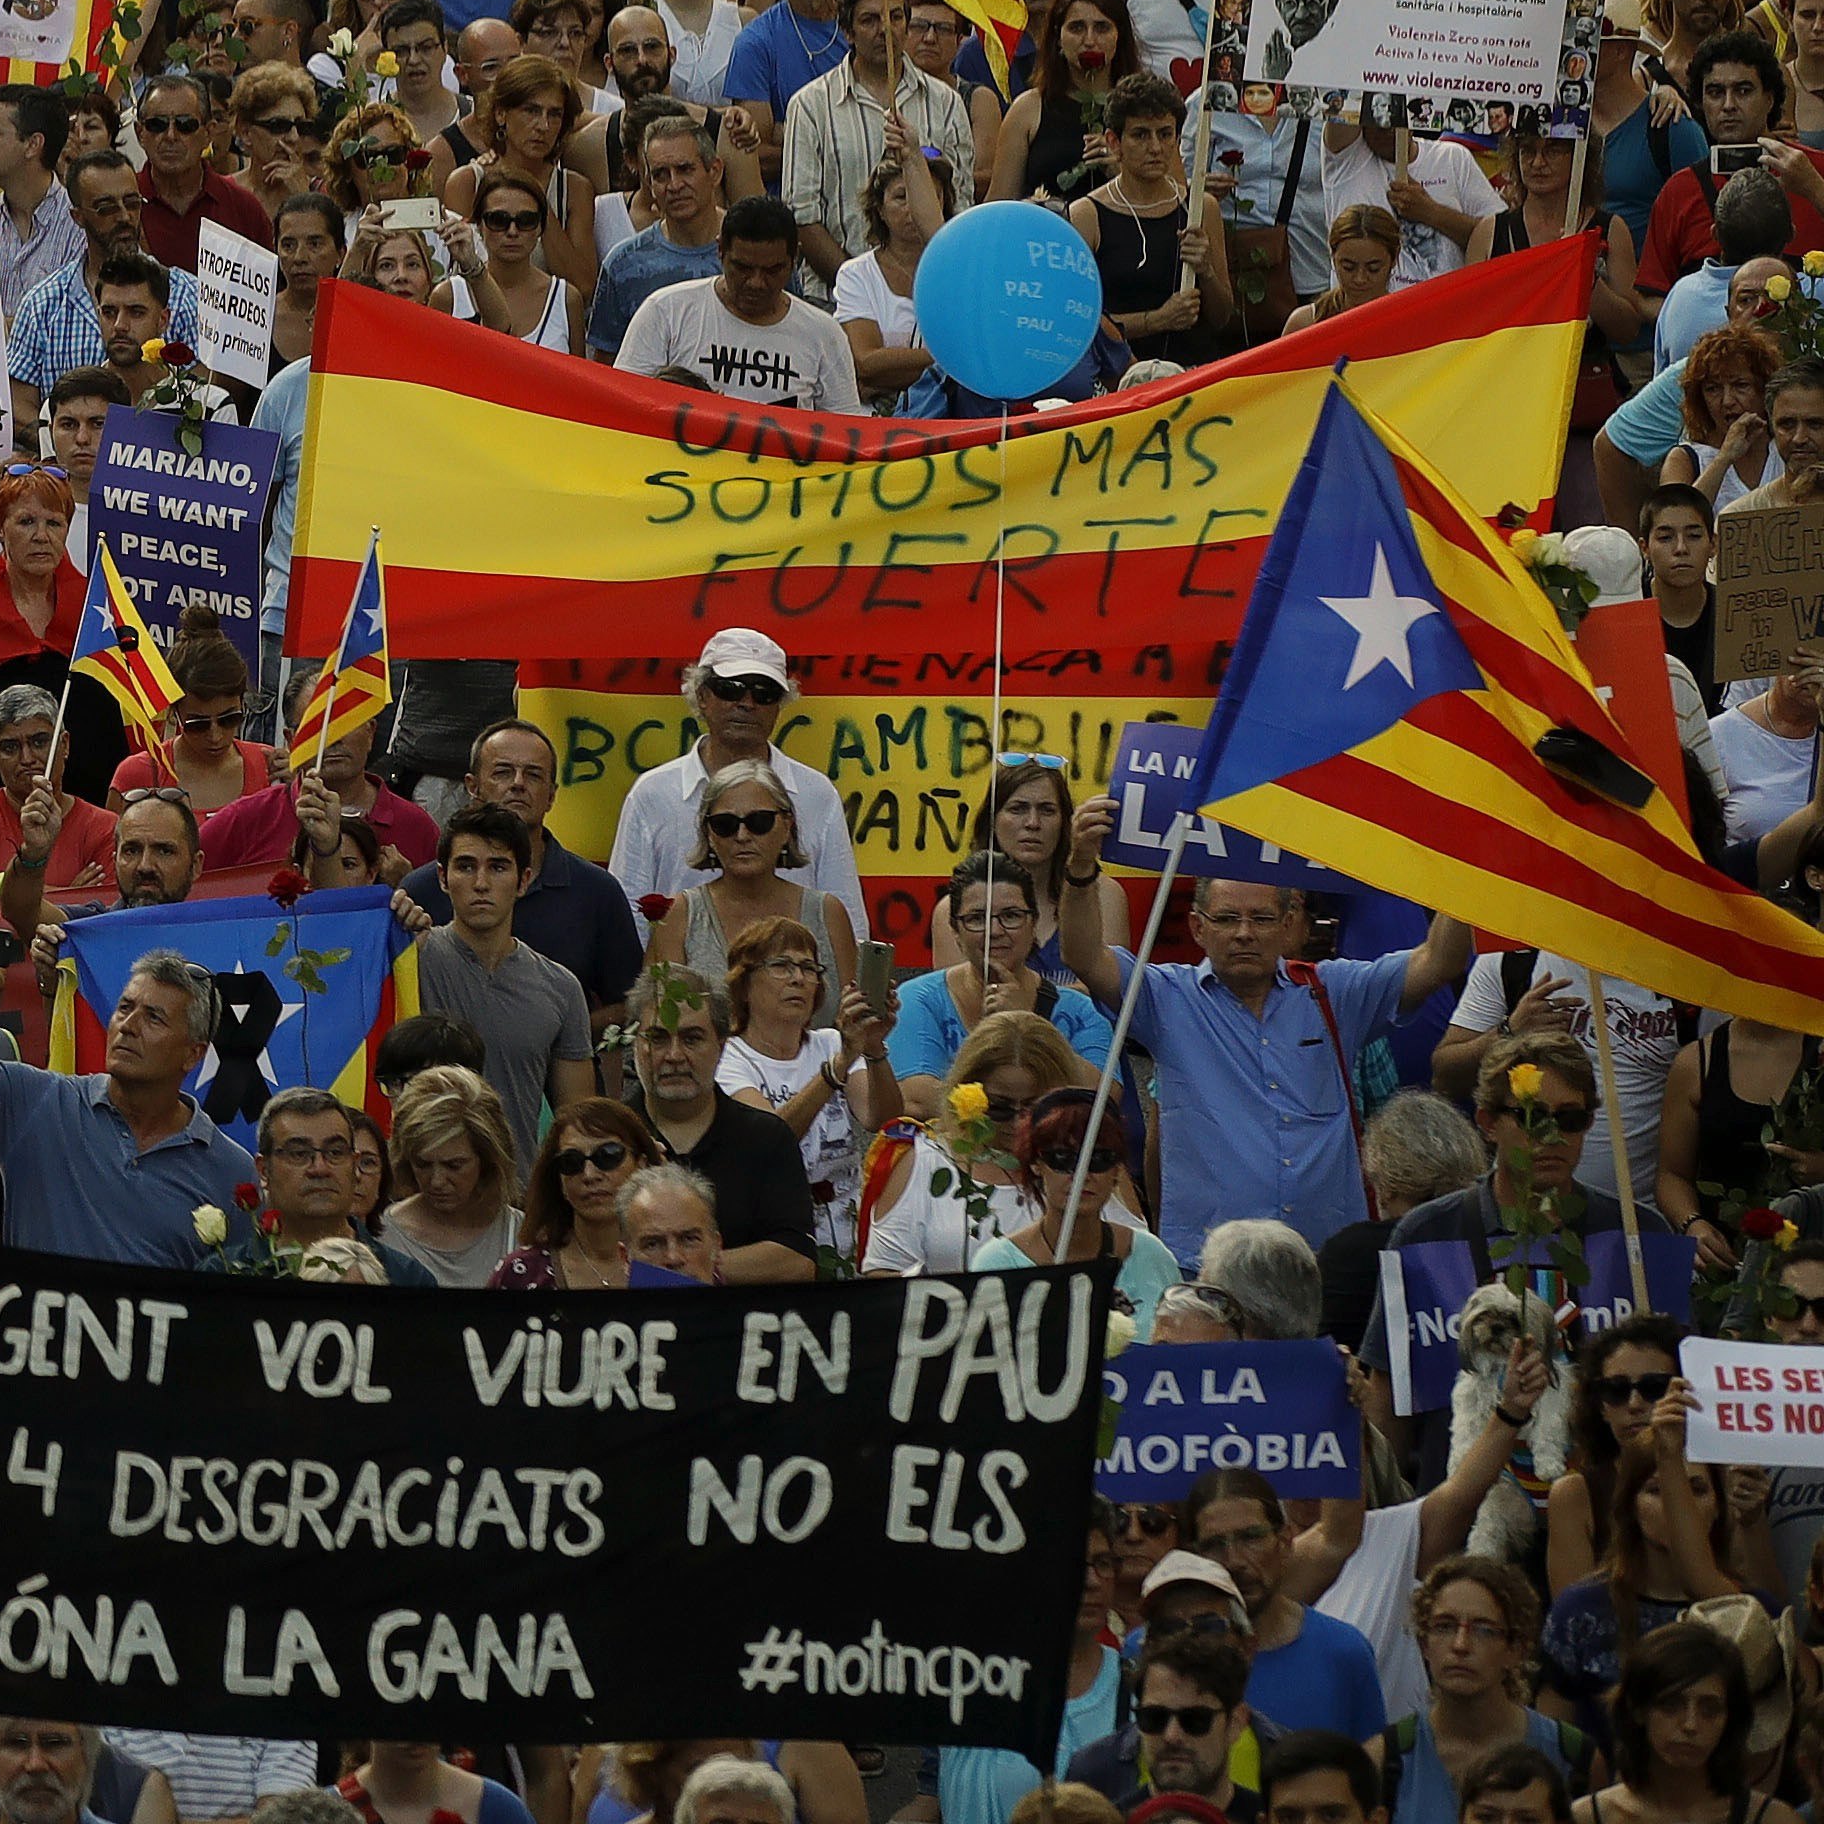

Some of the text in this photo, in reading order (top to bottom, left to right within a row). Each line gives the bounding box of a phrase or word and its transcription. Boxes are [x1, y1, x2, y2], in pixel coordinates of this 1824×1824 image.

[1362, 69, 1543, 98] www.violenziazero.org
[1027, 240, 1097, 281] PEACE
[1004, 281, 1043, 299] PAZ
[1017, 316, 1054, 332] PAU
[705, 342, 797, 390] WISH
[107, 442, 259, 494] MARIANO,
[644, 440, 1004, 526] SOMOS
[1050, 396, 1234, 496] MÁS
[103, 485, 249, 532] WE WANT
[120, 532, 228, 578] PEACE,
[690, 506, 1269, 621] FUERTE
[123, 575, 252, 619] OT ARMS
[253, 1318, 393, 1404] VOL
[738, 1308, 852, 1404] EN
[888, 1272, 1093, 1426] PAU
[7, 1425, 63, 1518] 4
[686, 1453, 834, 1547] NO
[885, 1443, 1028, 1557] ELS
[222, 1603, 341, 1699] LA
[366, 1607, 595, 1705] GANA
